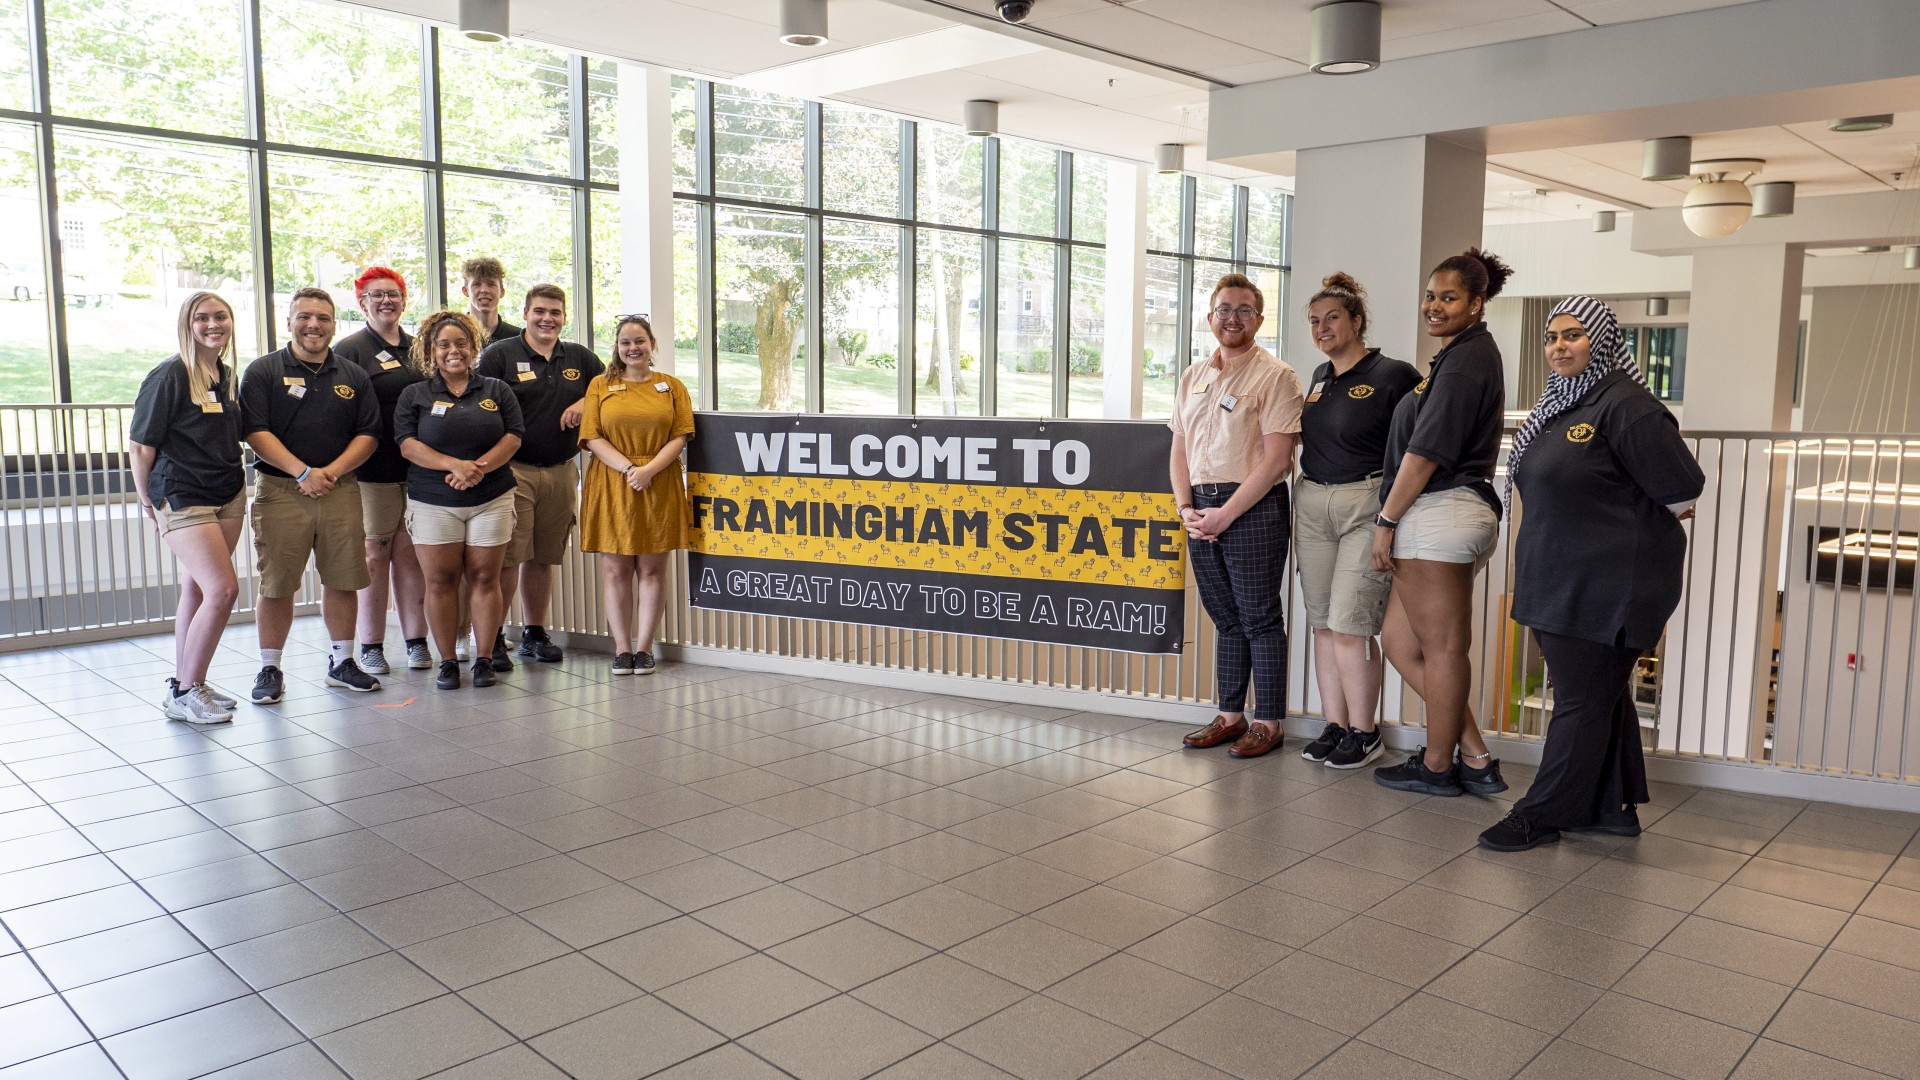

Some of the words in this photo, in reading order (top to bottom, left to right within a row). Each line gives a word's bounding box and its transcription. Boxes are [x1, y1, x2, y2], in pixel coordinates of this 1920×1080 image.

[734, 431, 997, 481] WELCOME
[1012, 438, 1091, 485] TO
[692, 495, 989, 549] FRAMINGHAM
[1002, 512, 1181, 561] STATE
[699, 567, 721, 594] A
[726, 569, 833, 604] GREAT
[839, 578, 912, 611] DAY
[919, 584, 966, 616] TO
[974, 589, 1021, 622] BE
[1029, 594, 1058, 626] A
[1067, 596, 1167, 636] RAM!
